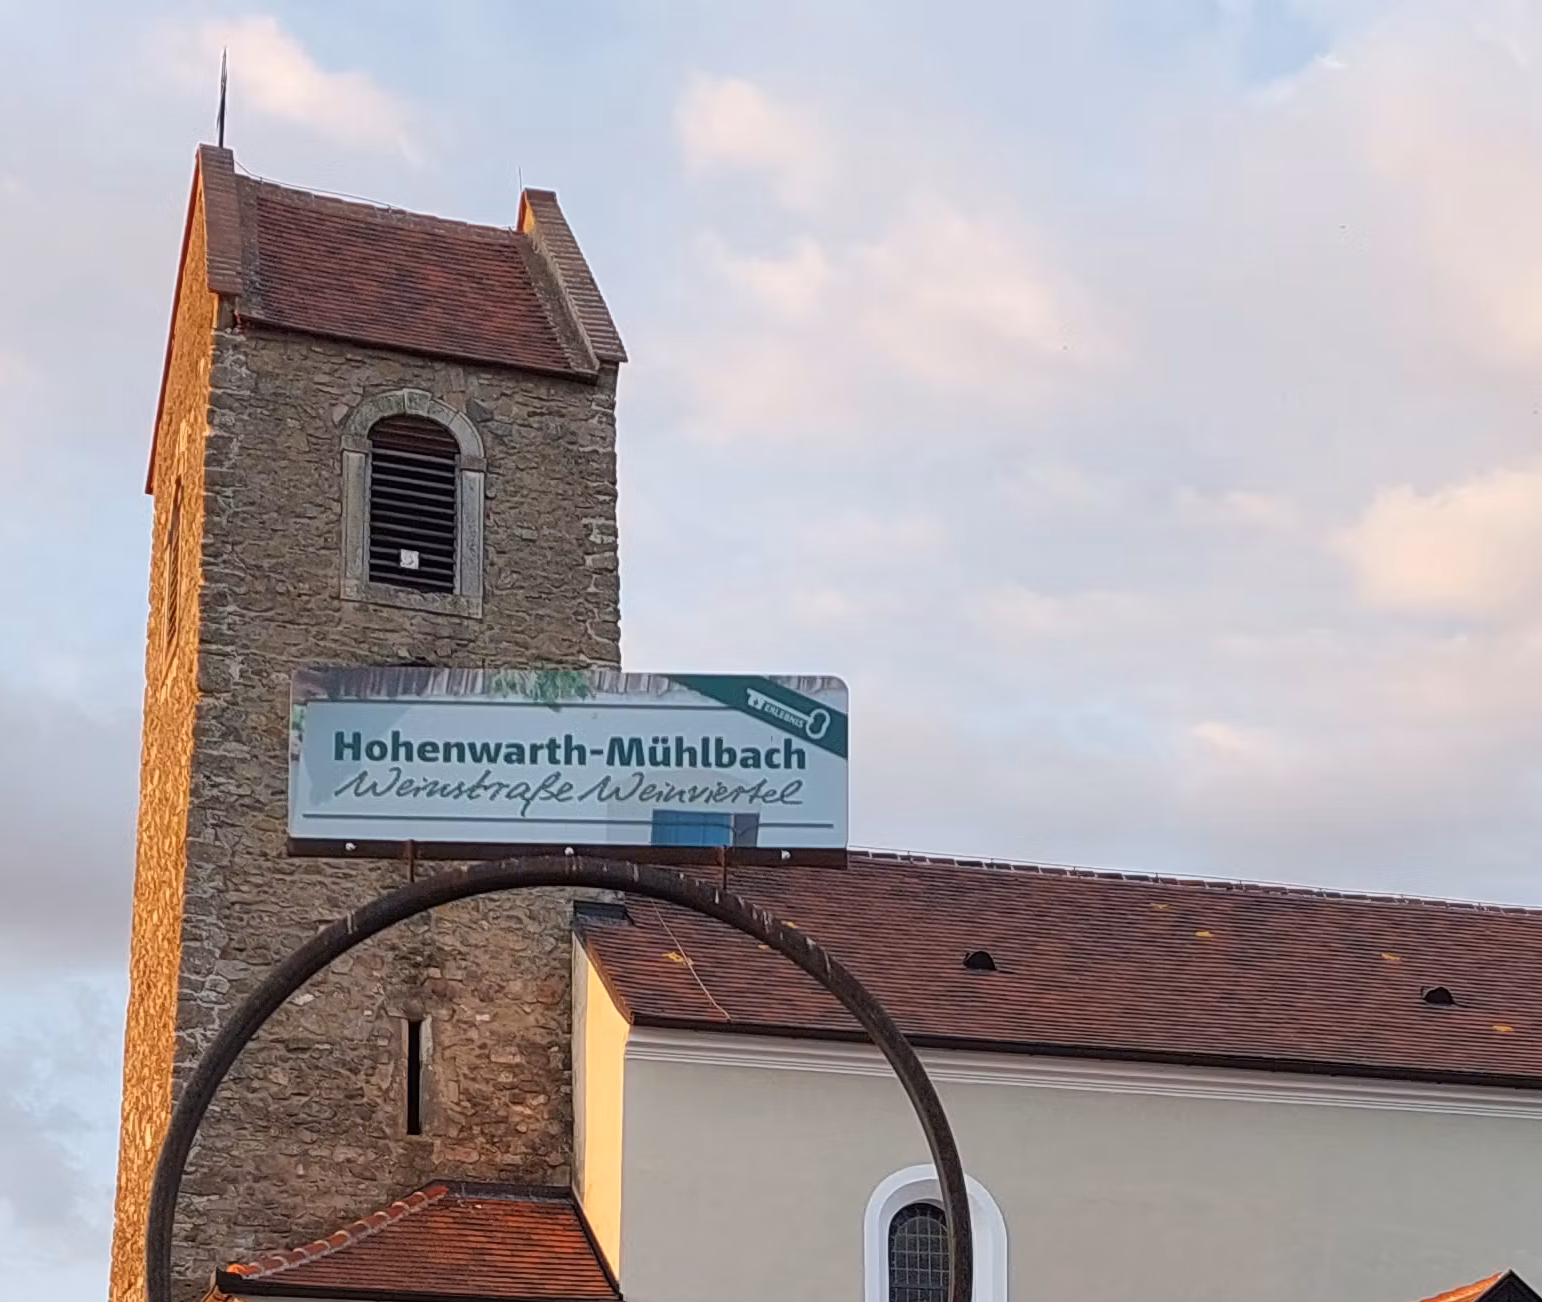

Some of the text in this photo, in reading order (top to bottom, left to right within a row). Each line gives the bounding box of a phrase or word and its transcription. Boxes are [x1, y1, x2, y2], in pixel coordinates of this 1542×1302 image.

[333, 730, 807, 770] Hohenwarth-Mühlbach
[334, 767, 804, 818] Weinstraße Weinviertel
